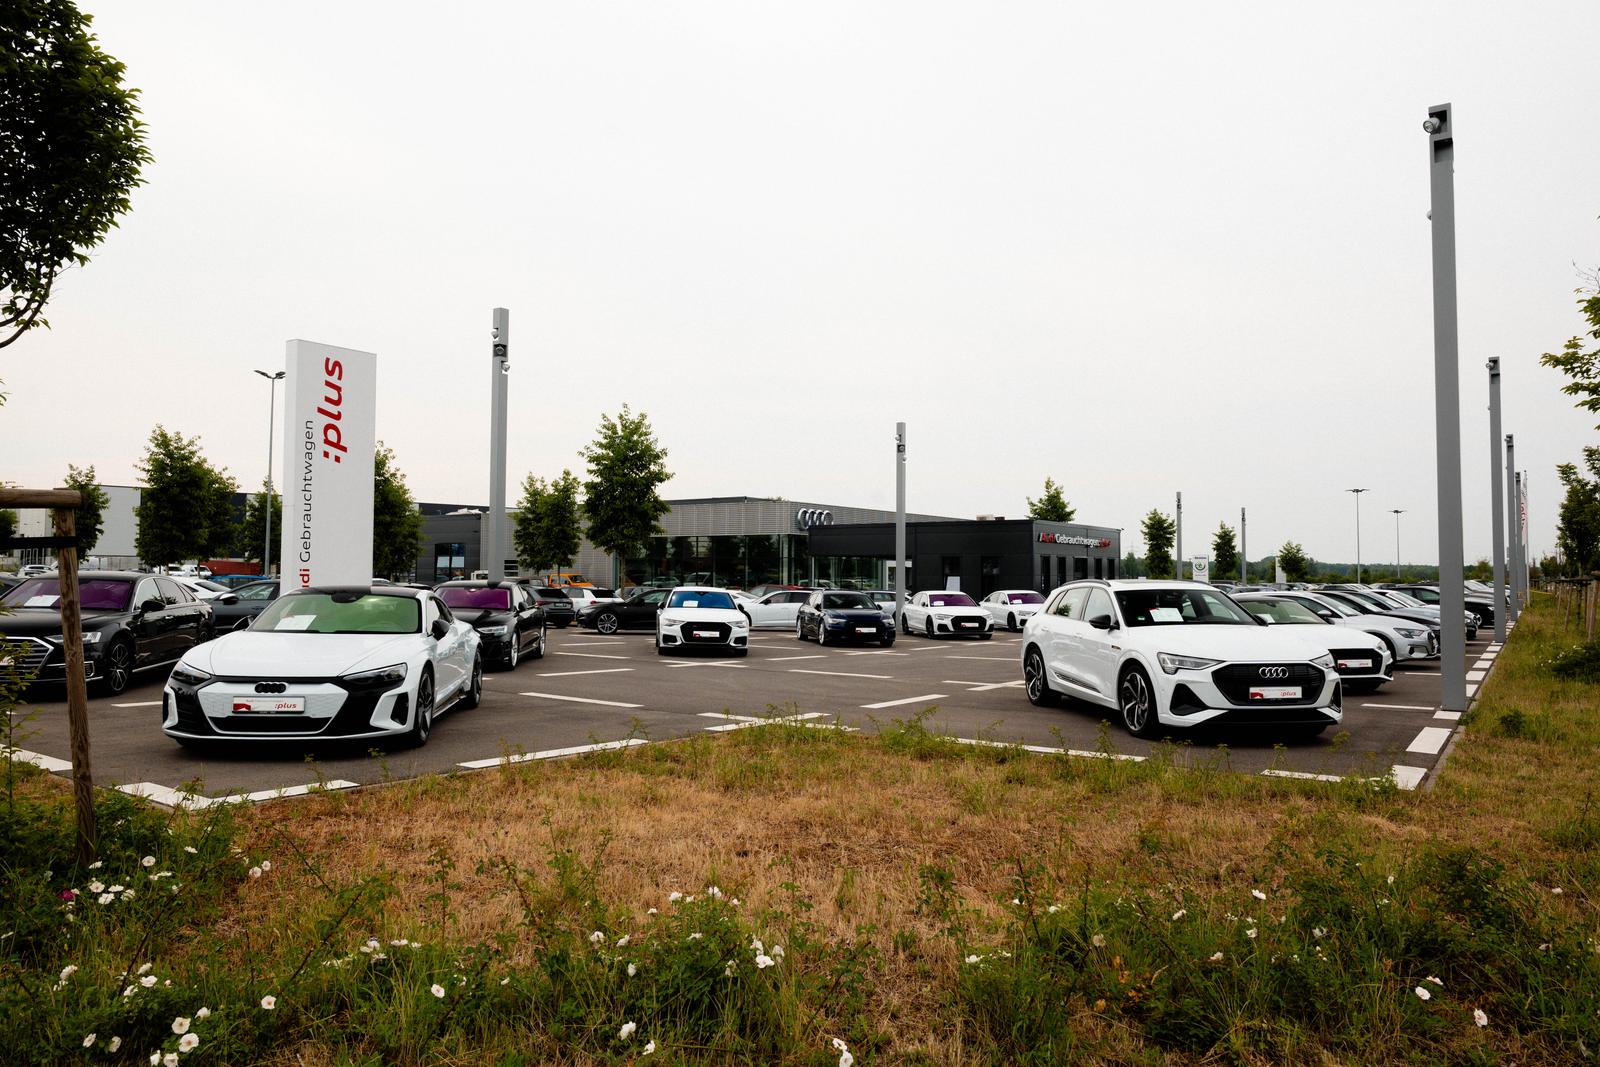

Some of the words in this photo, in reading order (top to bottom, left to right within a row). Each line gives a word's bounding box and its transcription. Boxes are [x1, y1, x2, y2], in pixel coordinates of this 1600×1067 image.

[317, 357, 348, 464] :plus
[300, 420, 316, 562] Gebrauchtwagen
[299, 568, 310, 588] di
